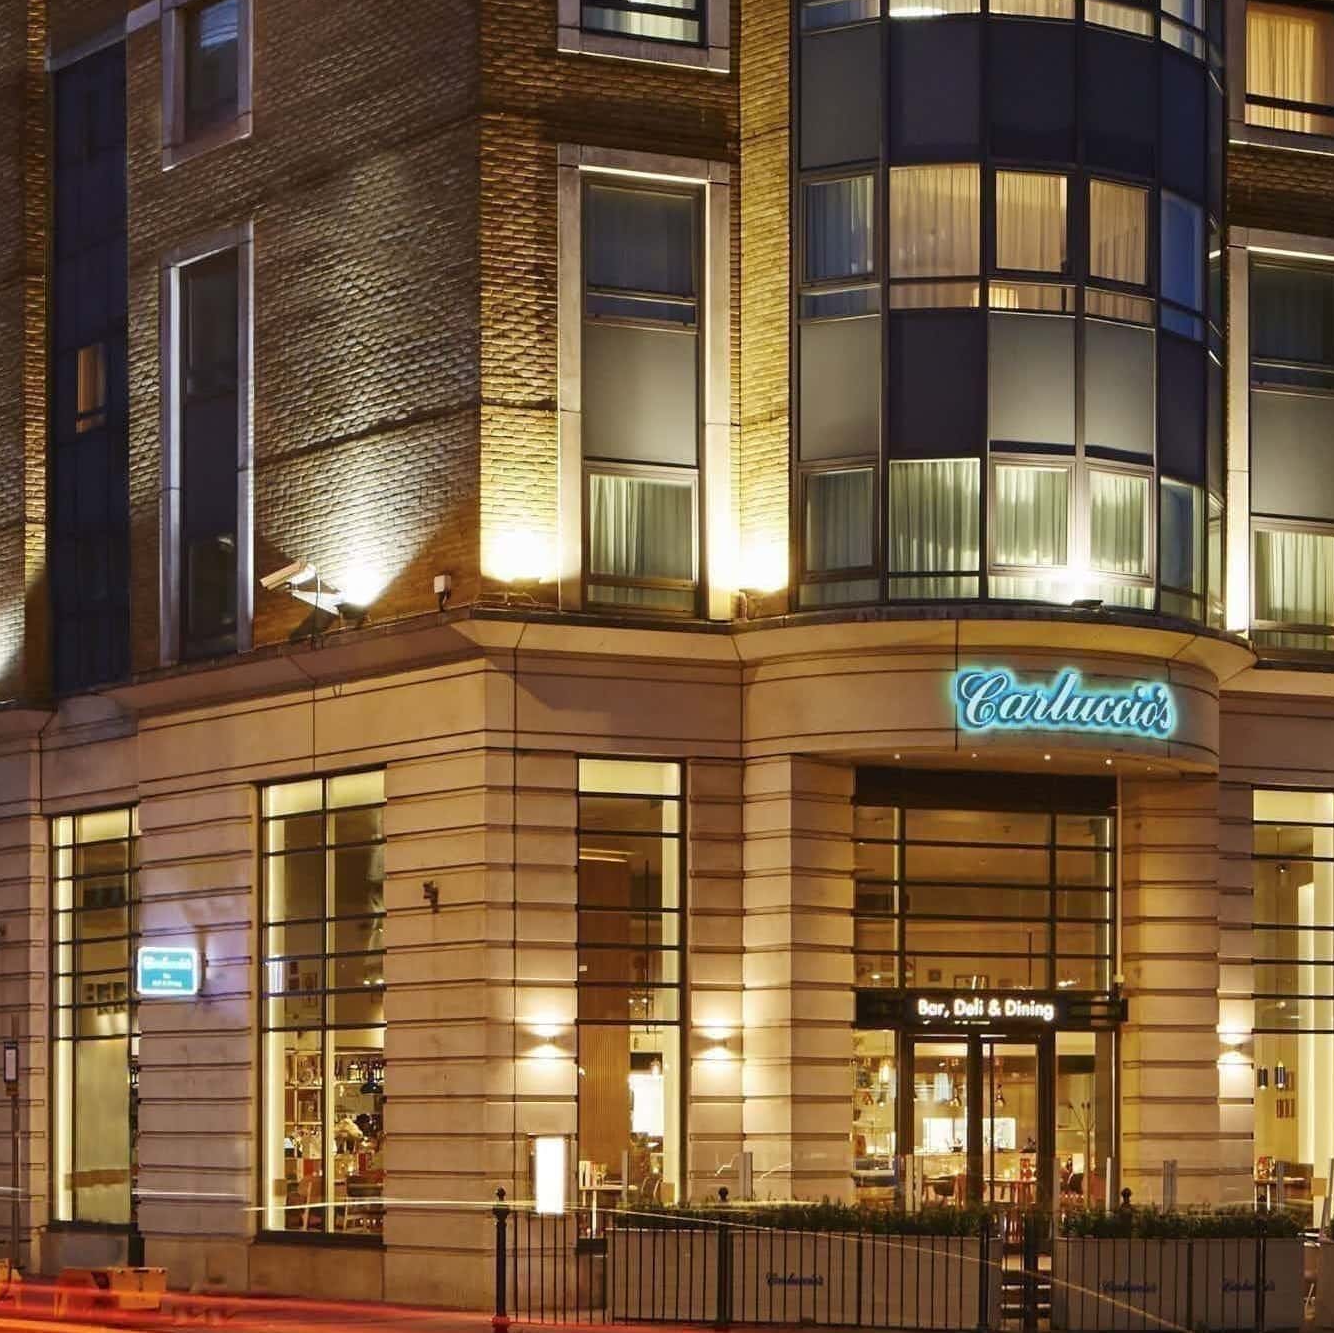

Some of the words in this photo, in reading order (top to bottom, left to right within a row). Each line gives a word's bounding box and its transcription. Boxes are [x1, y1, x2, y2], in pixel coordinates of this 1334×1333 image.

[959, 672, 1173, 730] Carluccio's
[918, 998, 950, 1019] Bar,
[953, 997, 984, 1017] Deli
[987, 998, 1002, 1017] &
[1004, 998, 1055, 1022] Dining
